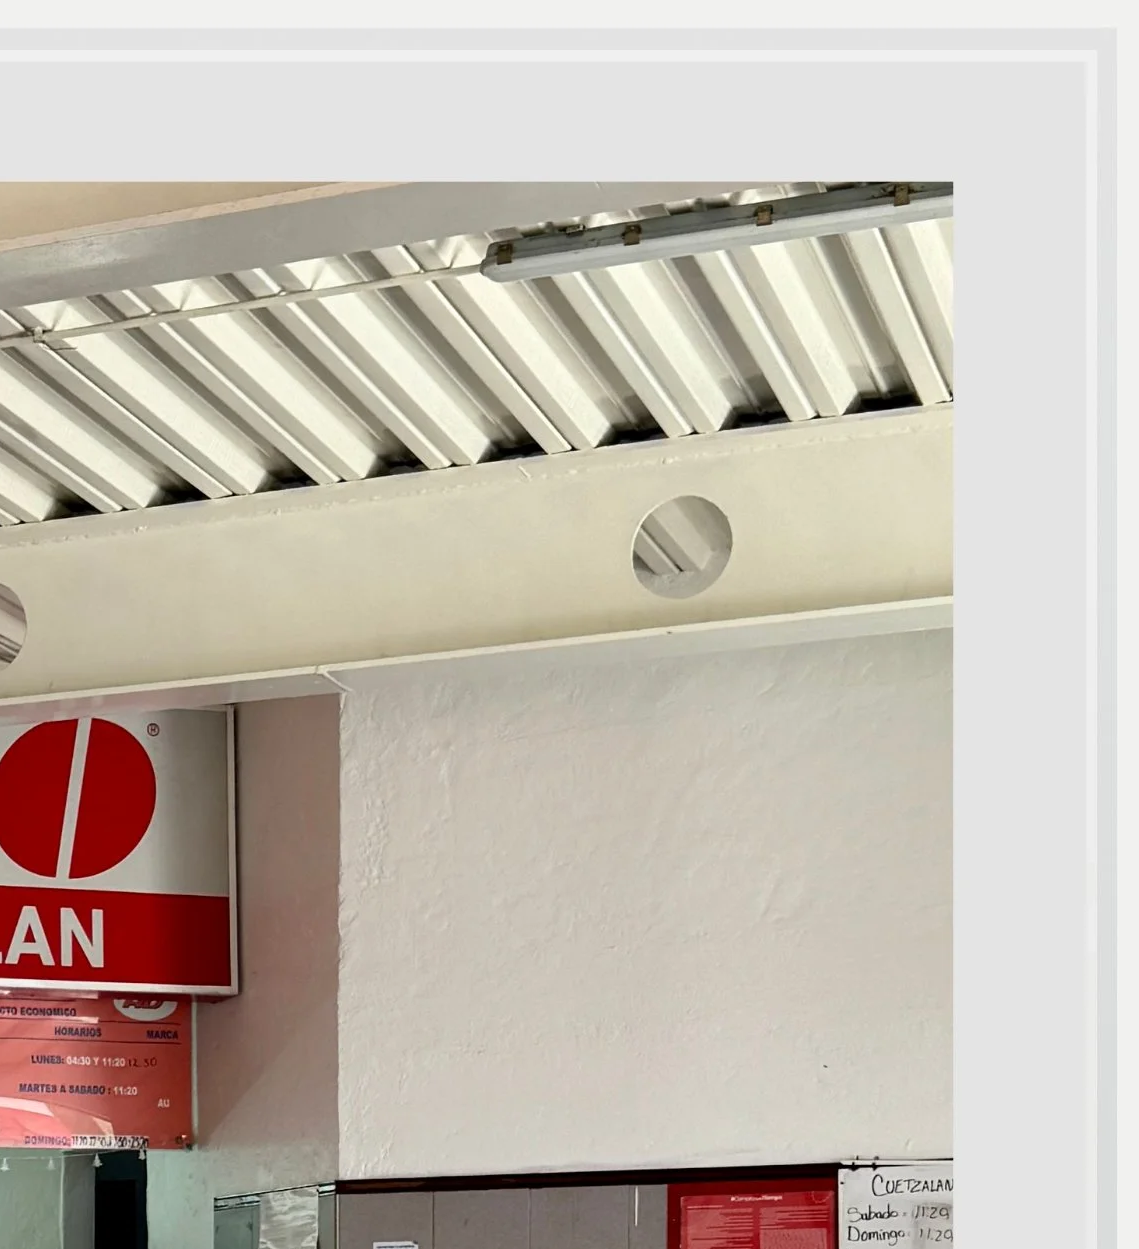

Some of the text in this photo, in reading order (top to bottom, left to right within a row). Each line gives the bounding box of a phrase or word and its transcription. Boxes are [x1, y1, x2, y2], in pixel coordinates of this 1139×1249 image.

[20, 1007, 76, 1016] ECONOMICO
[54, 1027, 102, 1037] HORARIOS
[146, 1030, 179, 1040] MARCA
[66, 1056, 91, 1066] 04:30
[93, 1057, 100, 1066] Y
[102, 1057, 126, 1067] 11:20
[19, 1083, 57, 1093] MARTES
[60, 1085, 66, 1093] A
[69, 1085, 105, 1095] SABADO
[113, 1086, 138, 1096] 11:20
[157, 1099, 170, 1108] AU
[872, 1174, 953, 1197] CUETZALAN
